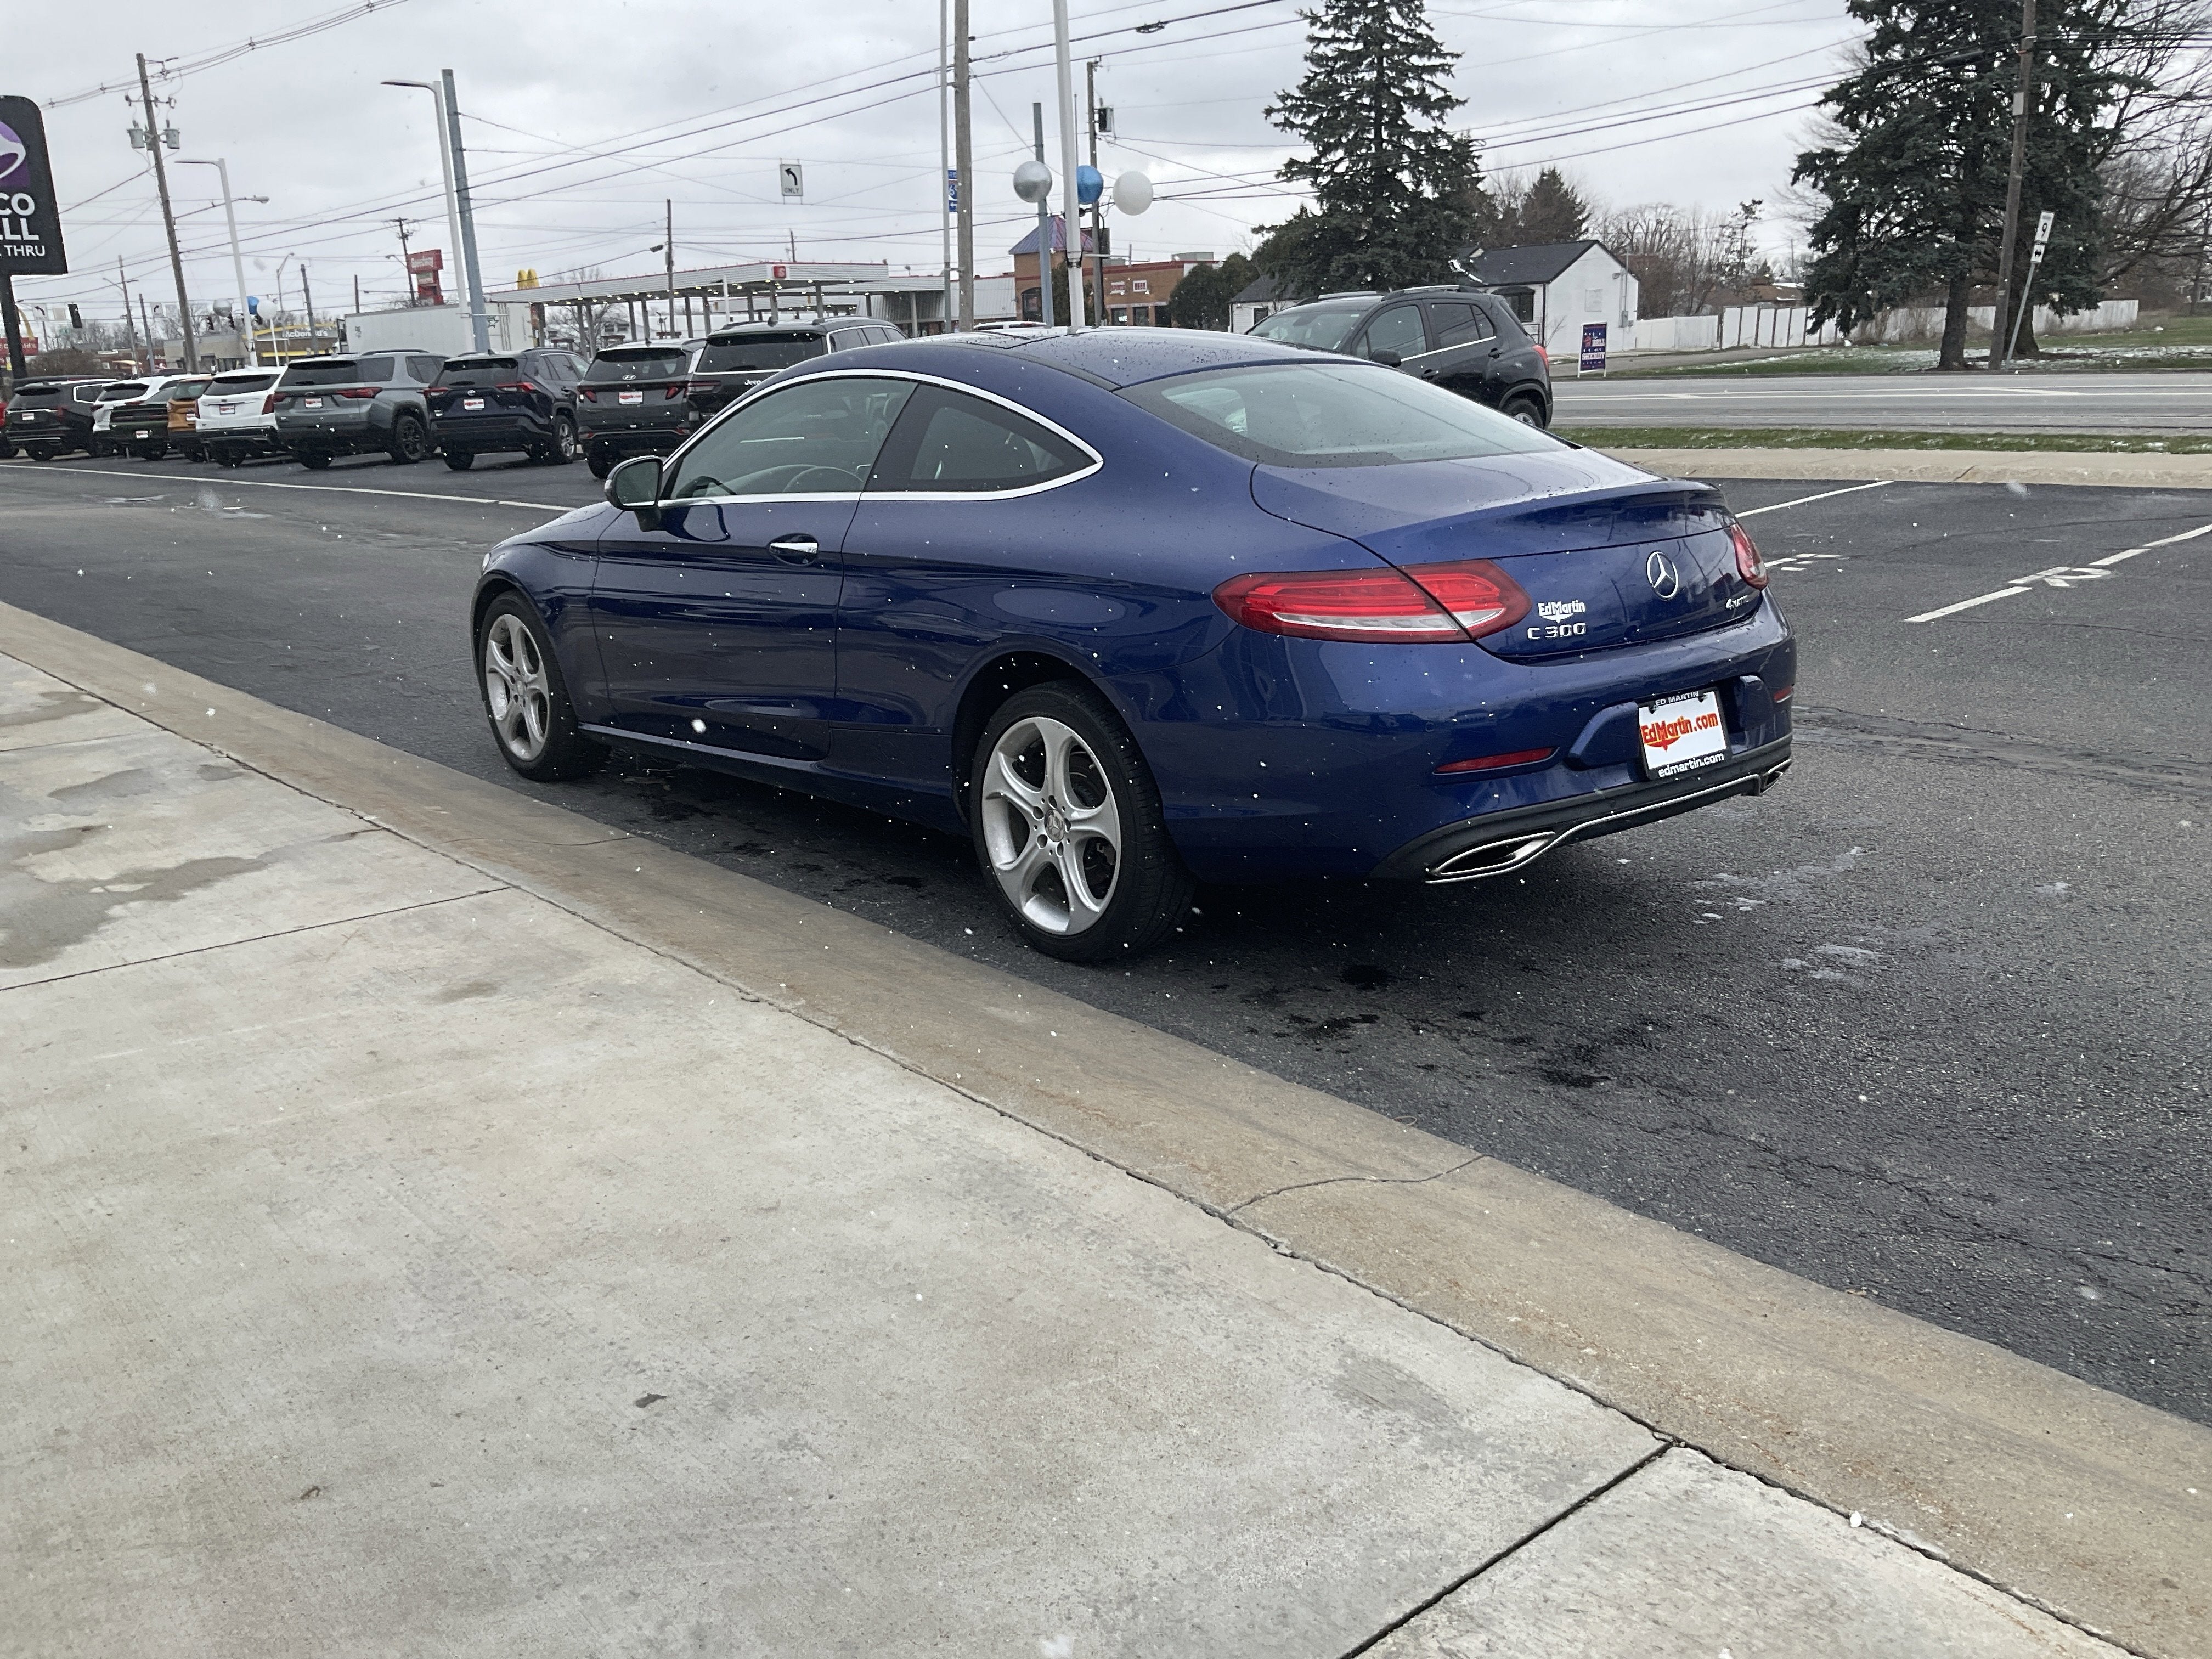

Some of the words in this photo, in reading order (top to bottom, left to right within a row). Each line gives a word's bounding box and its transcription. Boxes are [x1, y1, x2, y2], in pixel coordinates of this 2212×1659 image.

[0, 217, 40, 240] LL
[2042, 222, 2047, 237] 9
[4, 245, 46, 256] THRU
[1538, 600, 1585, 616] EdMartin
[1527, 627, 1541, 640] C
[1544, 622, 1587, 638] 300
[1668, 691, 1699, 703] MARTIN
[1640, 713, 1719, 744] EdMartin.com
[1658, 753, 1725, 777] edmartin.com
